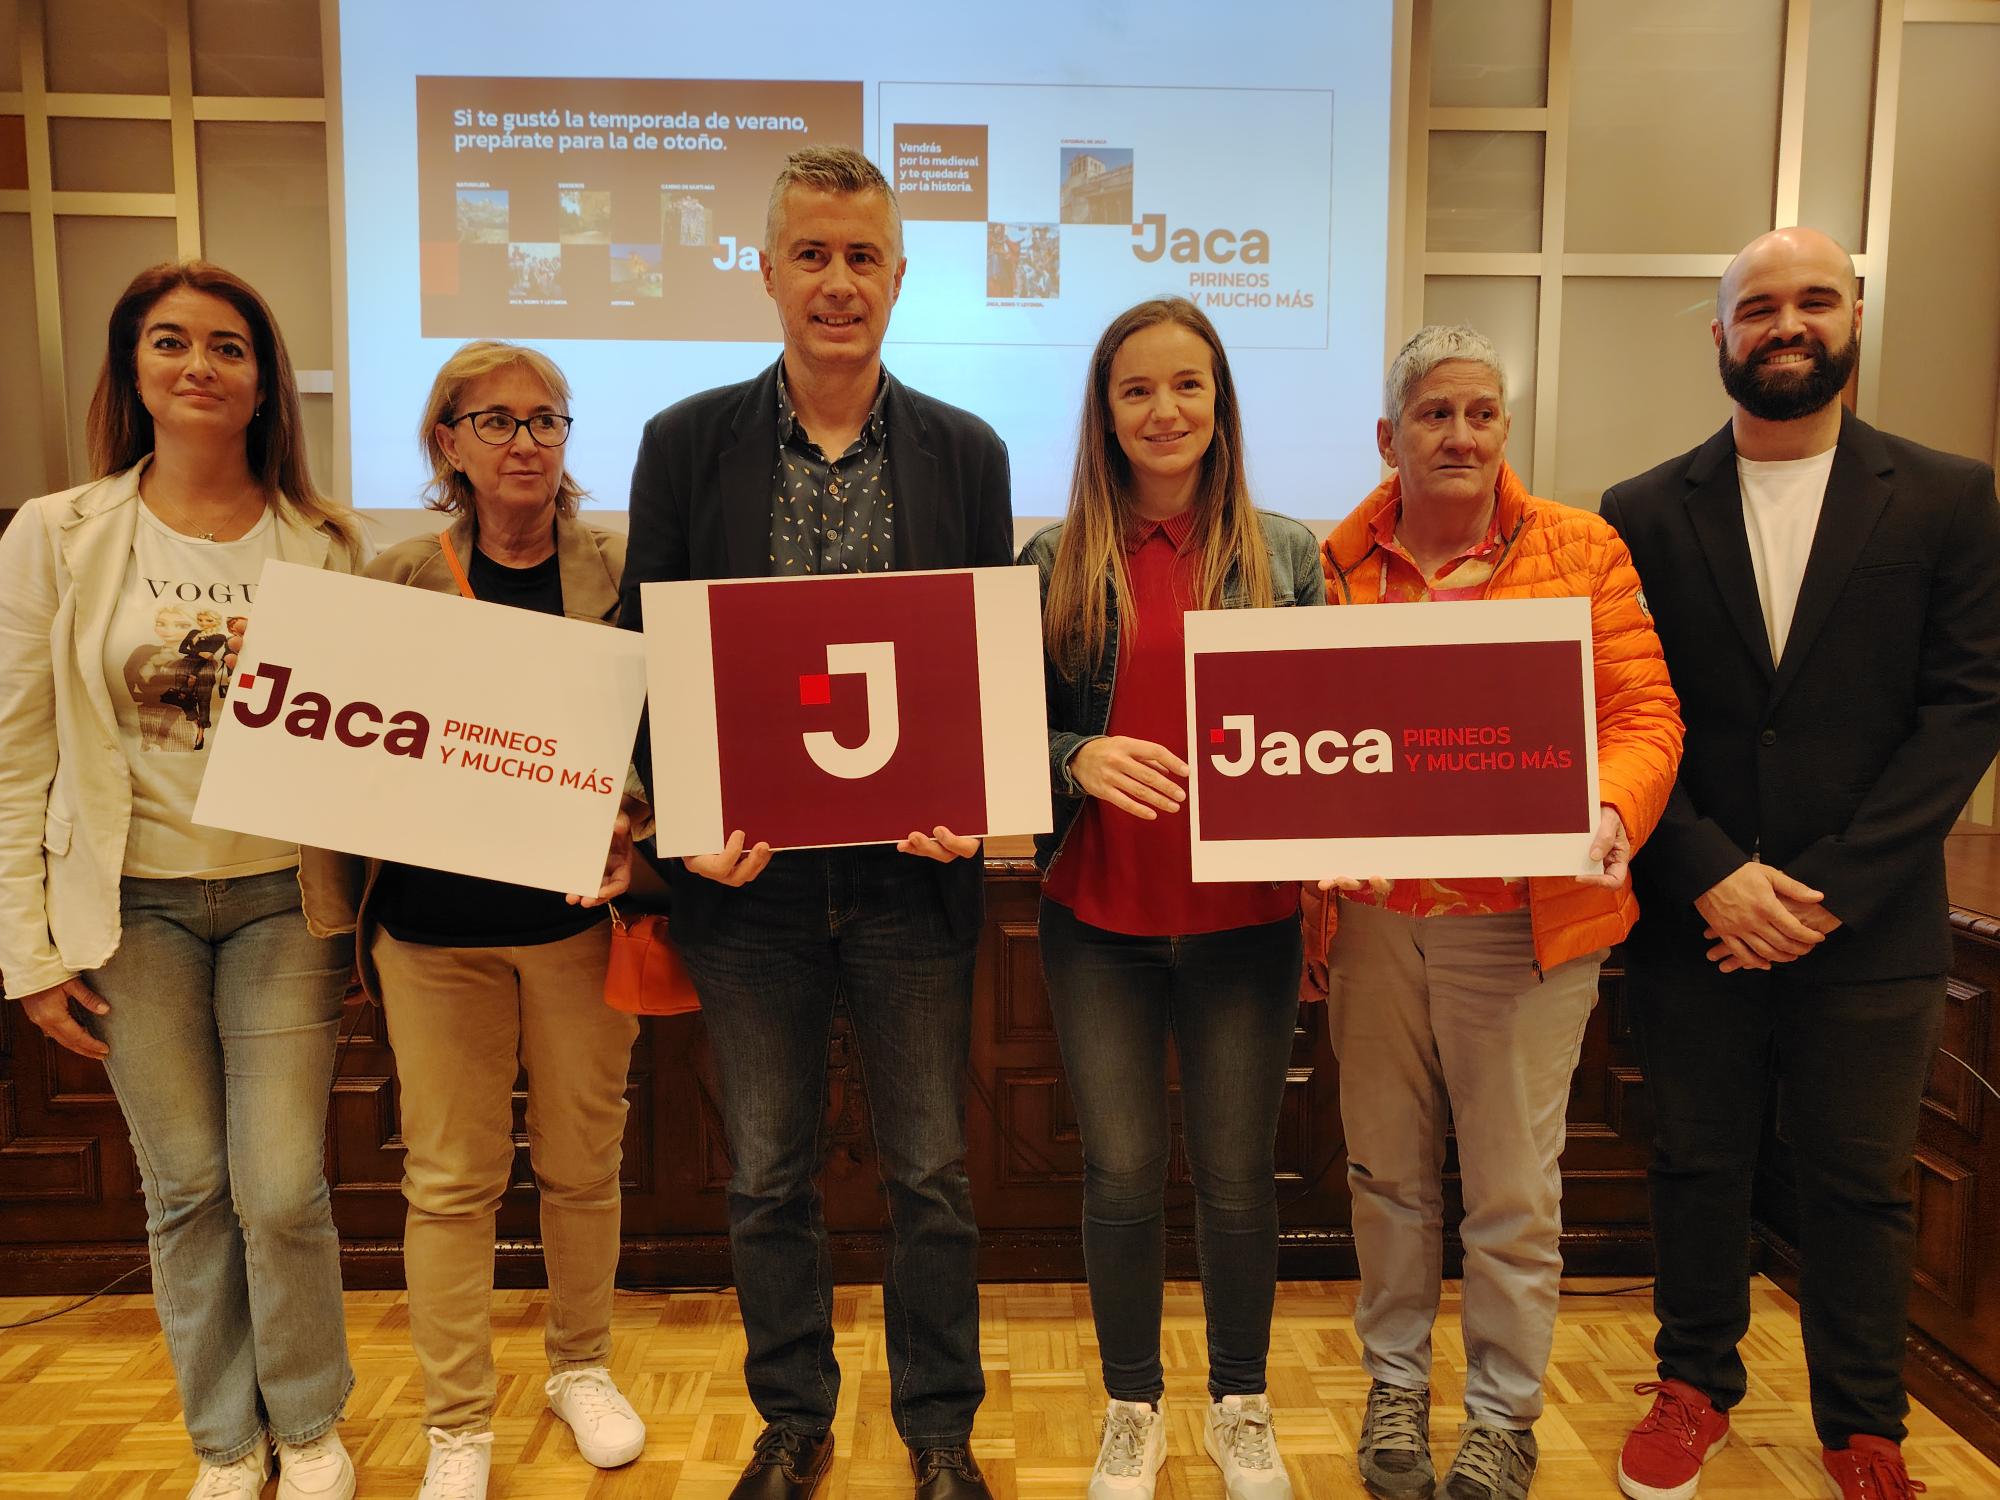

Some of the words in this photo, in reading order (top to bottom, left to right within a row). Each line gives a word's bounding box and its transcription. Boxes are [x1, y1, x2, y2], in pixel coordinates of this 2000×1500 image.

[454, 109, 473, 127] Si
[477, 111, 498, 127] te
[503, 109, 561, 131] gustó
[565, 110, 584, 128] la
[588, 111, 700, 133] temporada
[705, 112, 730, 129] de
[735, 115, 808, 133] verano,
[455, 131, 553, 153] prepárate
[559, 135, 604, 153] para
[609, 132, 628, 149] la
[633, 133, 658, 149] de
[663, 134, 728, 150] otoño.
[900, 142, 942, 153] Vendrás
[900, 157, 917, 167] por
[919, 156, 930, 166] lo
[932, 155, 979, 167] medieval
[900, 170, 907, 180] y
[909, 168, 920, 178] te
[921, 168, 969, 181] quedarás
[900, 182, 917, 193] por
[919, 181, 930, 191] la
[931, 181, 974, 192] historia.
[1132, 214, 1270, 264] Jaca
[712, 236, 760, 272] Ja
[1189, 272, 1270, 288] PIRINEOS
[1190, 292, 1202, 307] Y
[1206, 292, 1271, 308] MUCHO
[1276, 290, 1314, 308] MÁS
[233, 662, 430, 759] Jaca
[802, 641, 899, 779] J
[443, 719, 558, 757] PIRINEOS
[1210, 714, 1393, 777] Jaca
[1403, 726, 1511, 747] PIRINEOS
[440, 745, 456, 765] Y
[461, 750, 554, 783] MUCHO
[559, 768, 614, 795] MÁS
[1404, 753, 1421, 772] Y
[1427, 751, 1516, 772] MUCHO
[1521, 745, 1573, 769] MÁS
